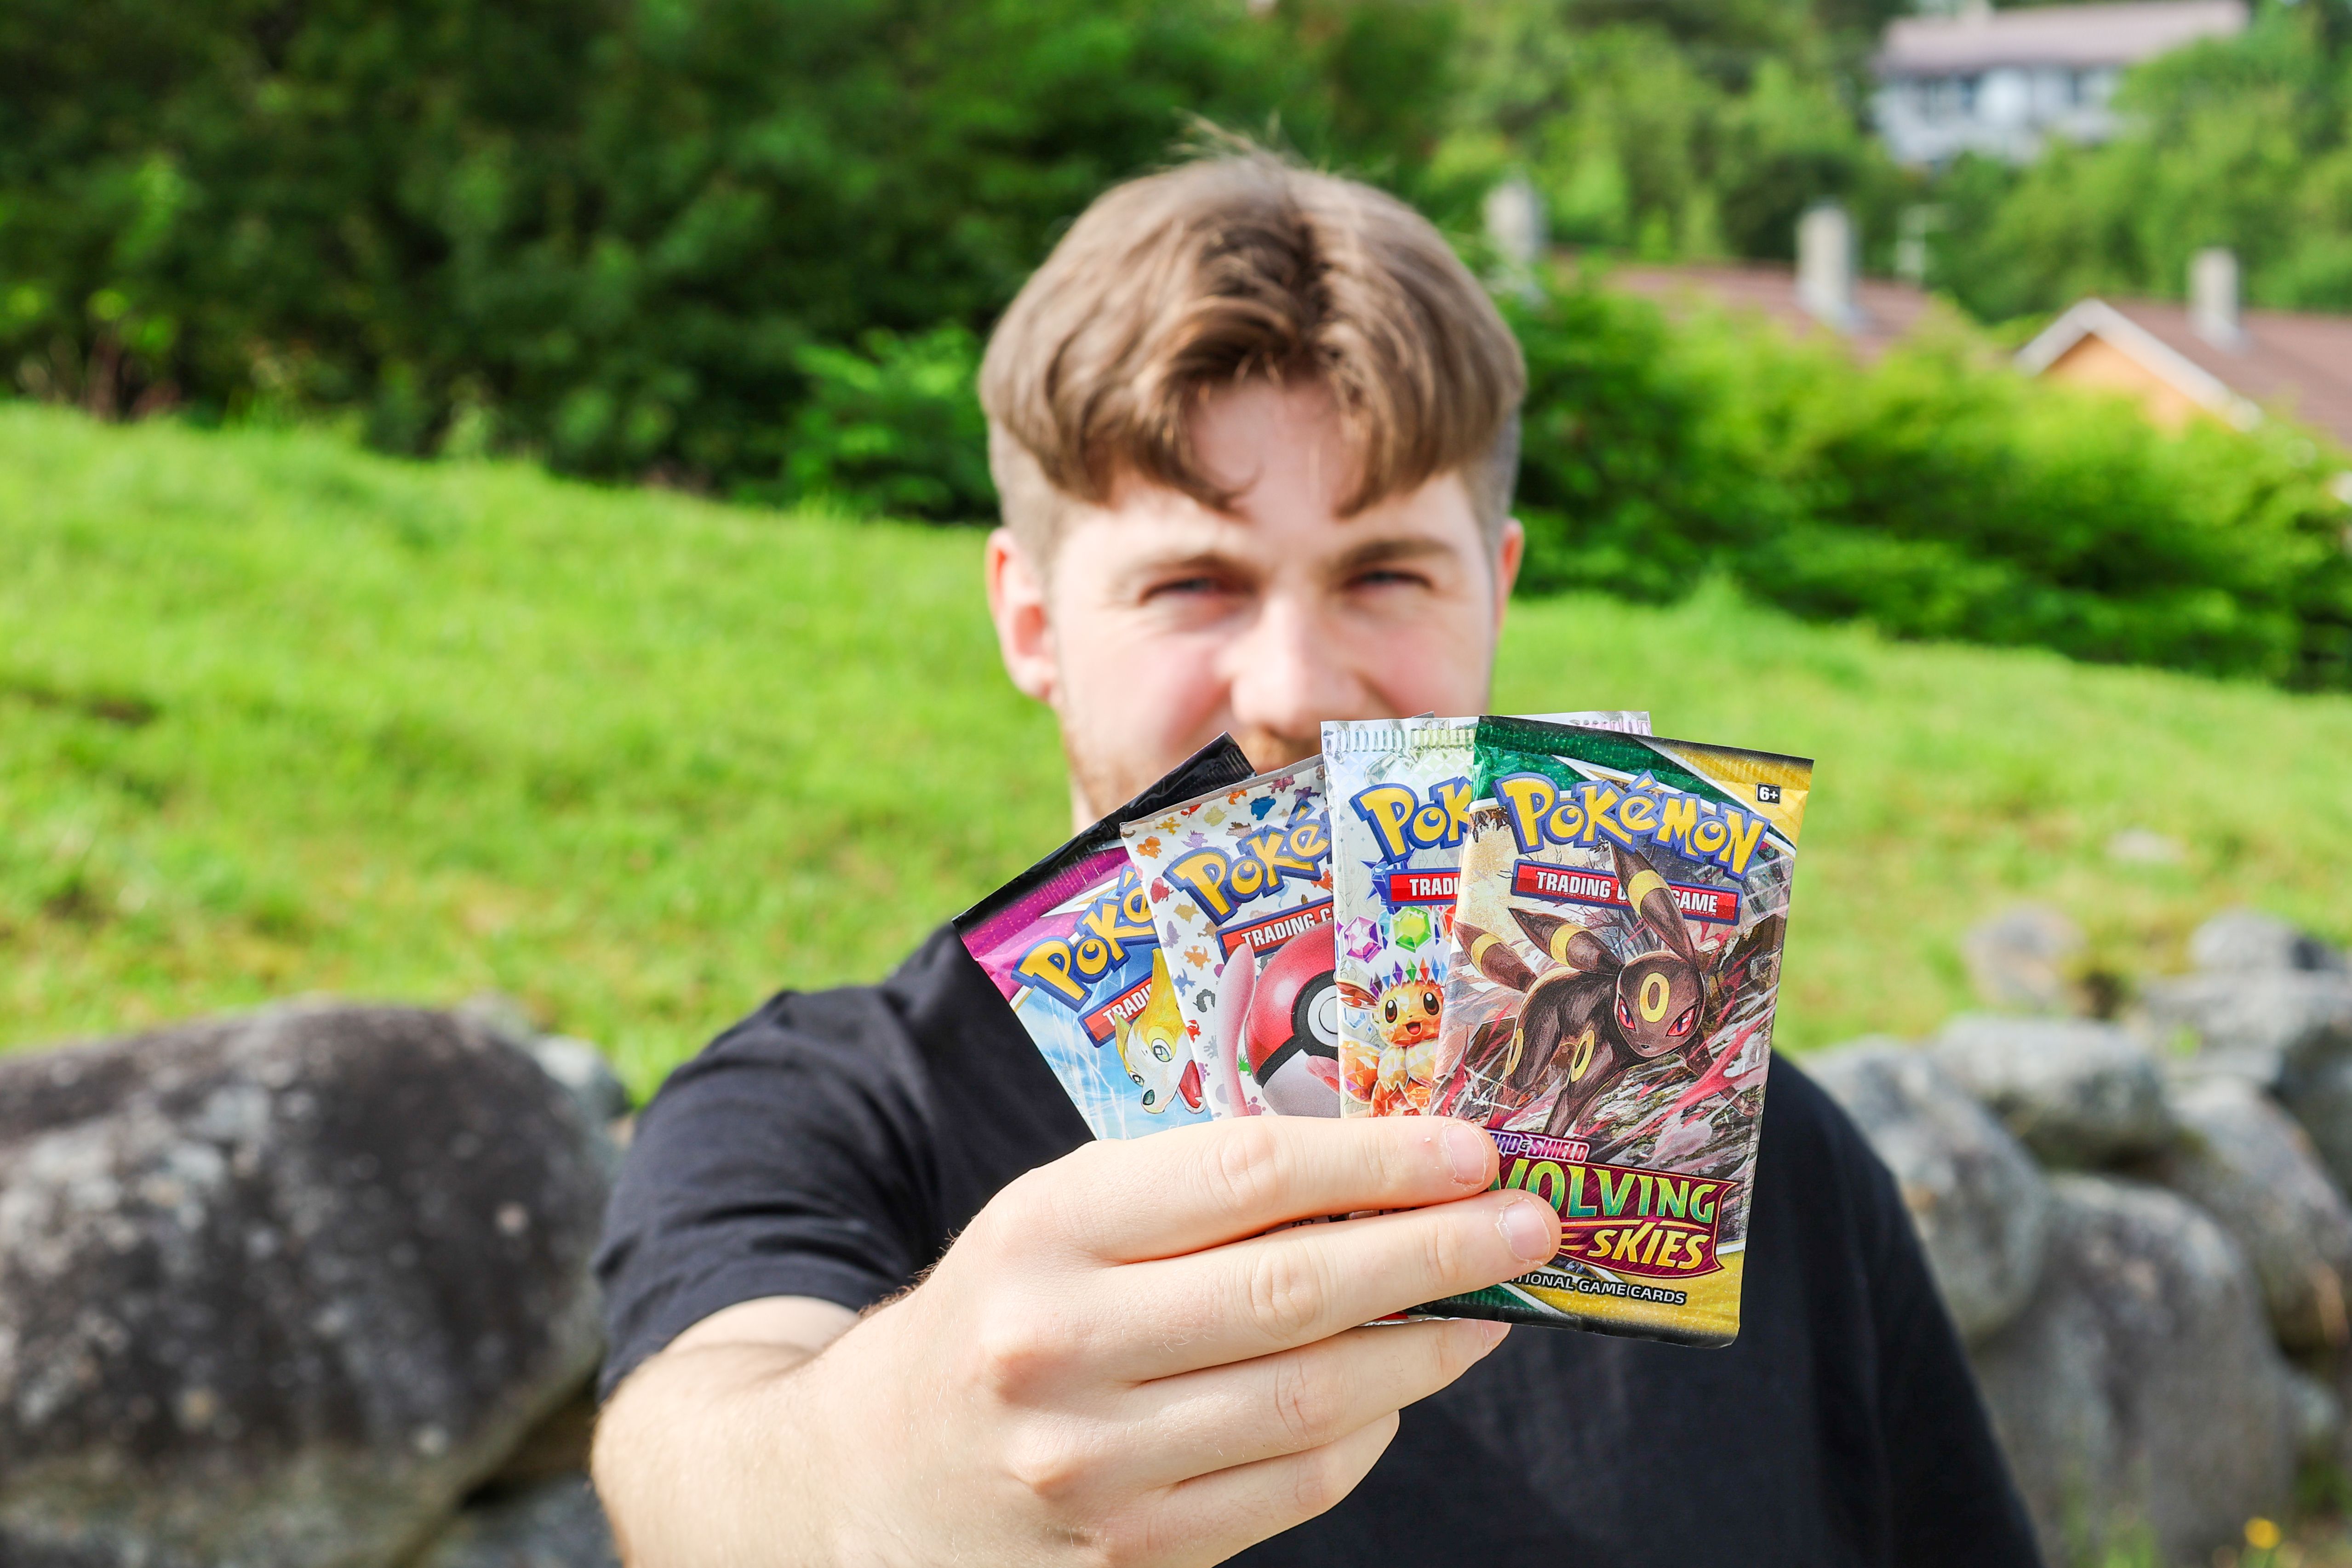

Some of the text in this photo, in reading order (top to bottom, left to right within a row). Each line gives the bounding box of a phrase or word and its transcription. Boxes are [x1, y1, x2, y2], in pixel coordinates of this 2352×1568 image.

[1759, 787, 1779, 801] 6+
[1409, 876, 1459, 896] TRADI
[1536, 871, 1612, 898] TRADING
[1241, 912, 1316, 947] TRADING
[1527, 1135, 1589, 1162] SHIELD
[1488, 1158, 1718, 1224] VOLVING
[1586, 1222, 1711, 1270] SKIES
[1578, 1280, 1627, 1296] GAME
[1631, 1285, 1685, 1304] CARDS
